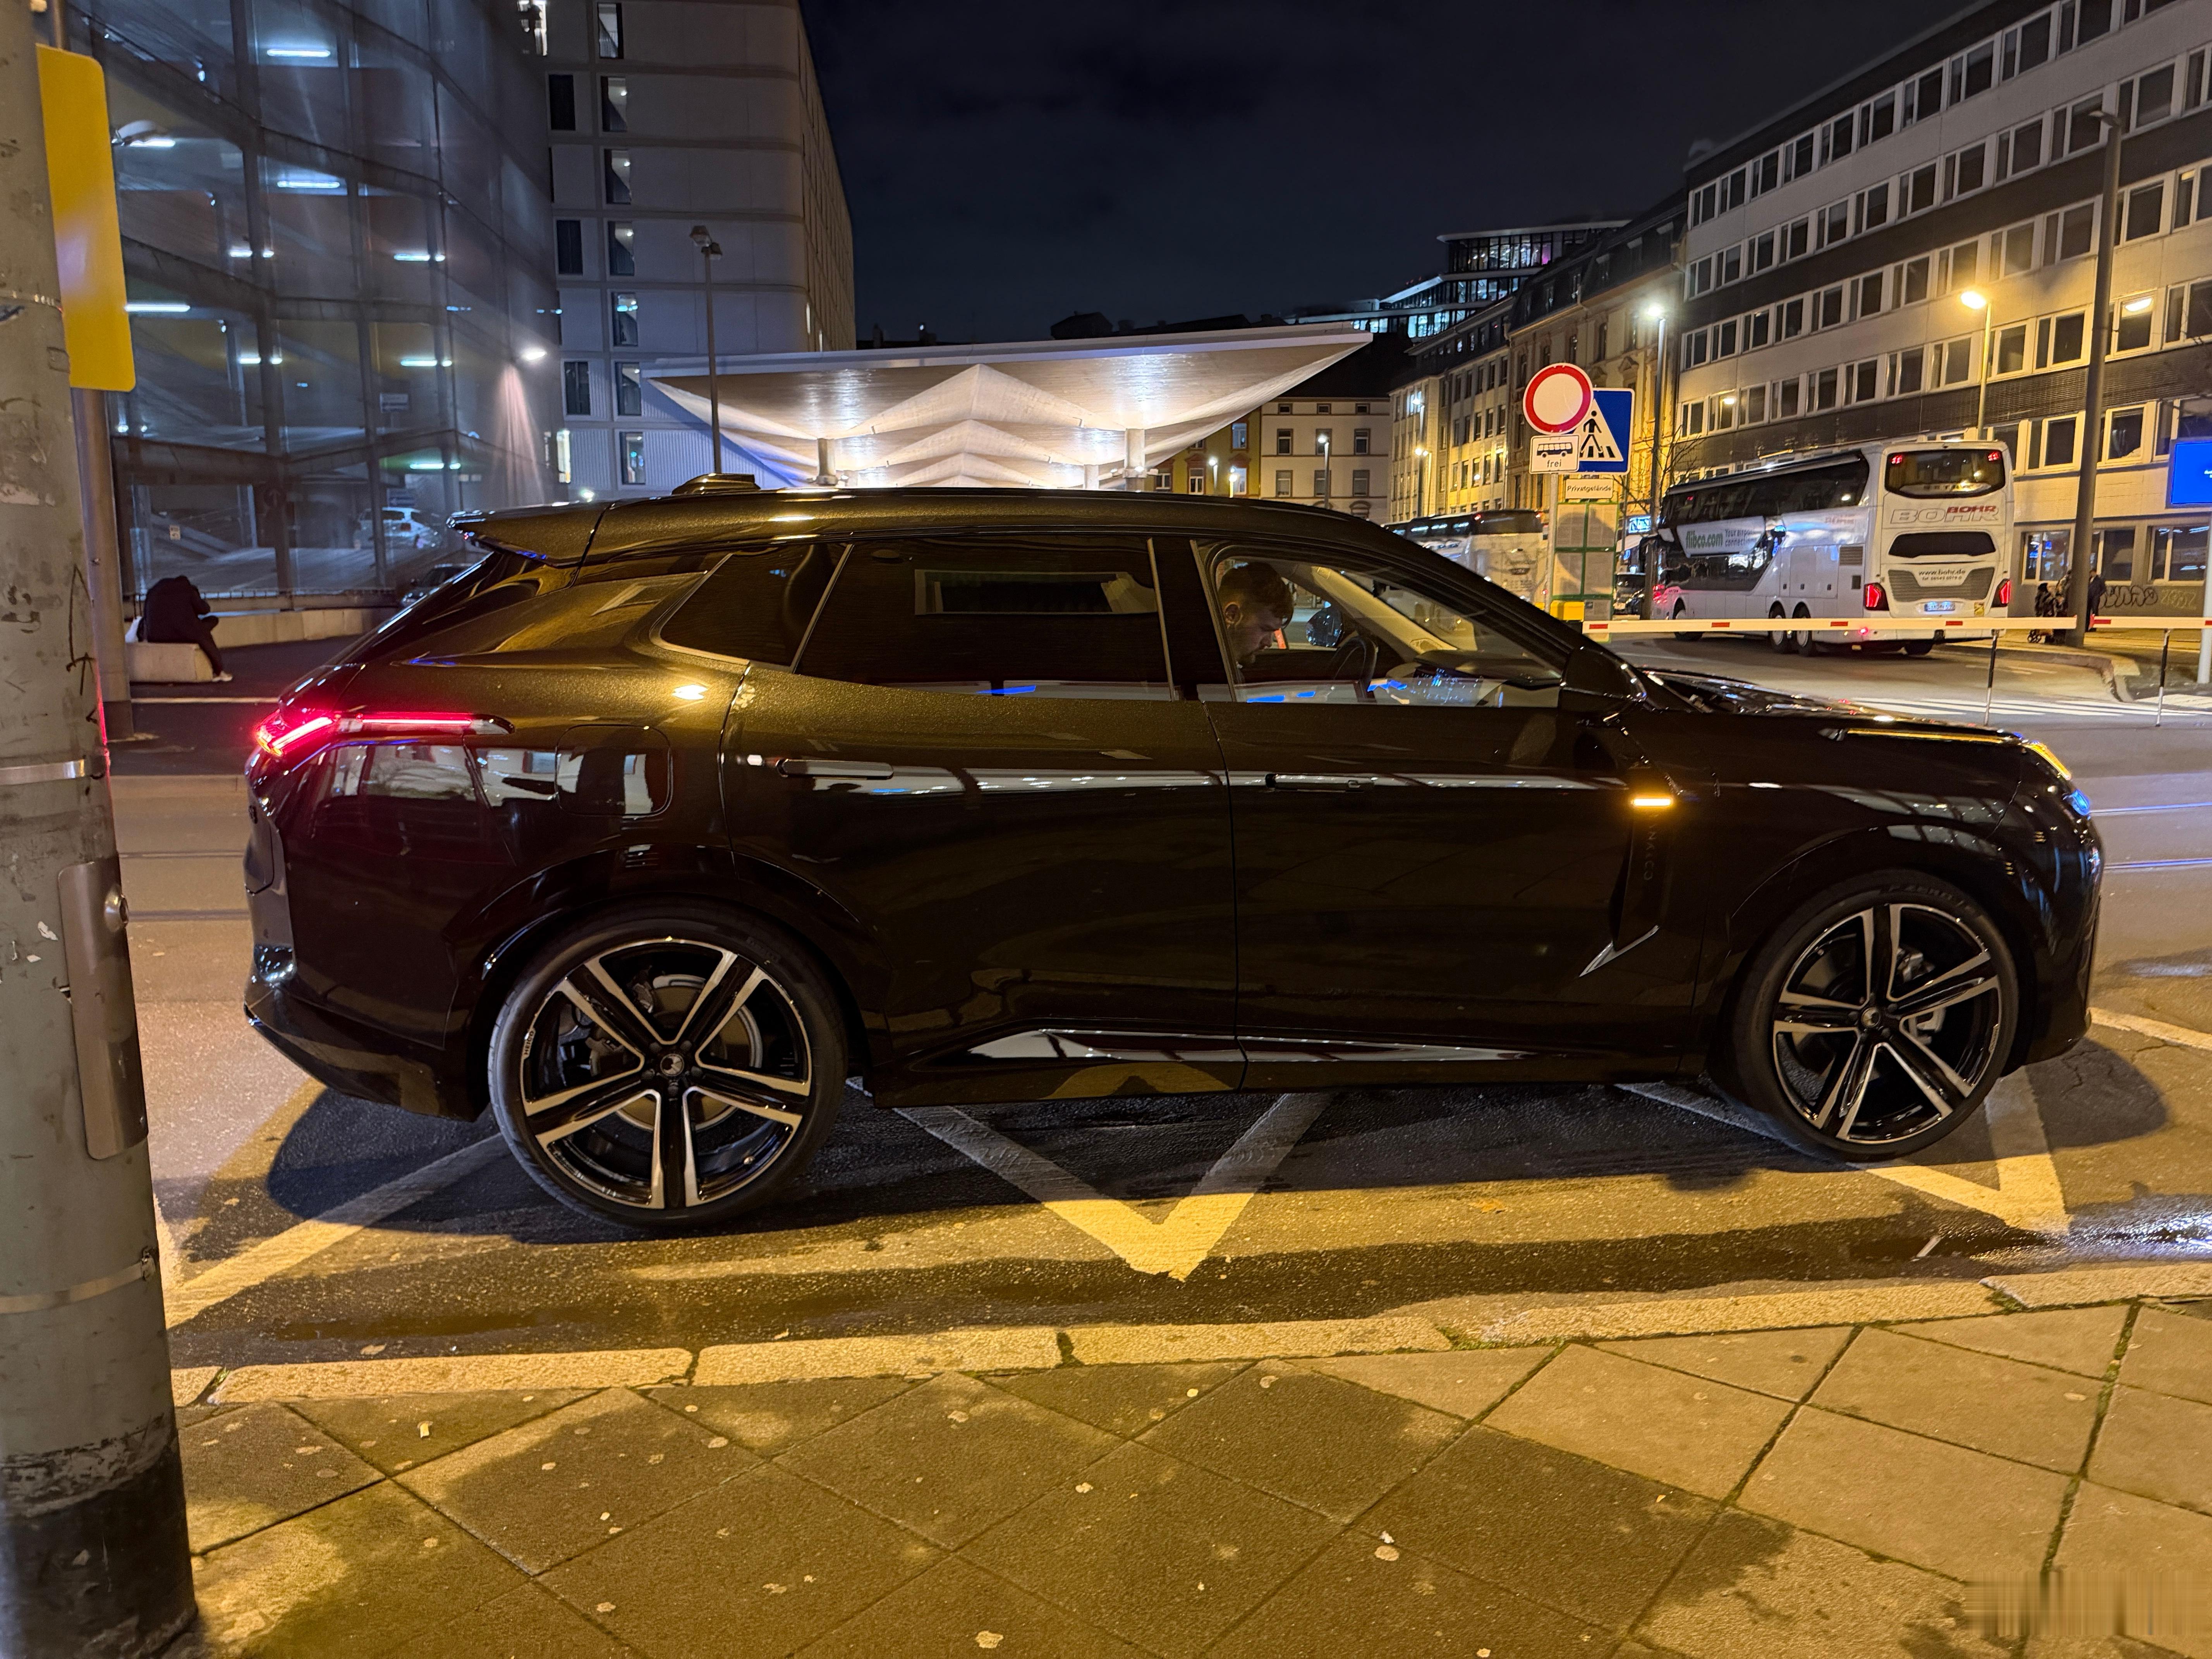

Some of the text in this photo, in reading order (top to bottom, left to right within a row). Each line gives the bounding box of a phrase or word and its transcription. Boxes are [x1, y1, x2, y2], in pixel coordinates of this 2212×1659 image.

[1547, 459, 1561, 468] frei
[1946, 505, 1997, 514] BOHR
[1725, 529, 1736, 538] Your
[1685, 530, 1723, 549] flibco.com
